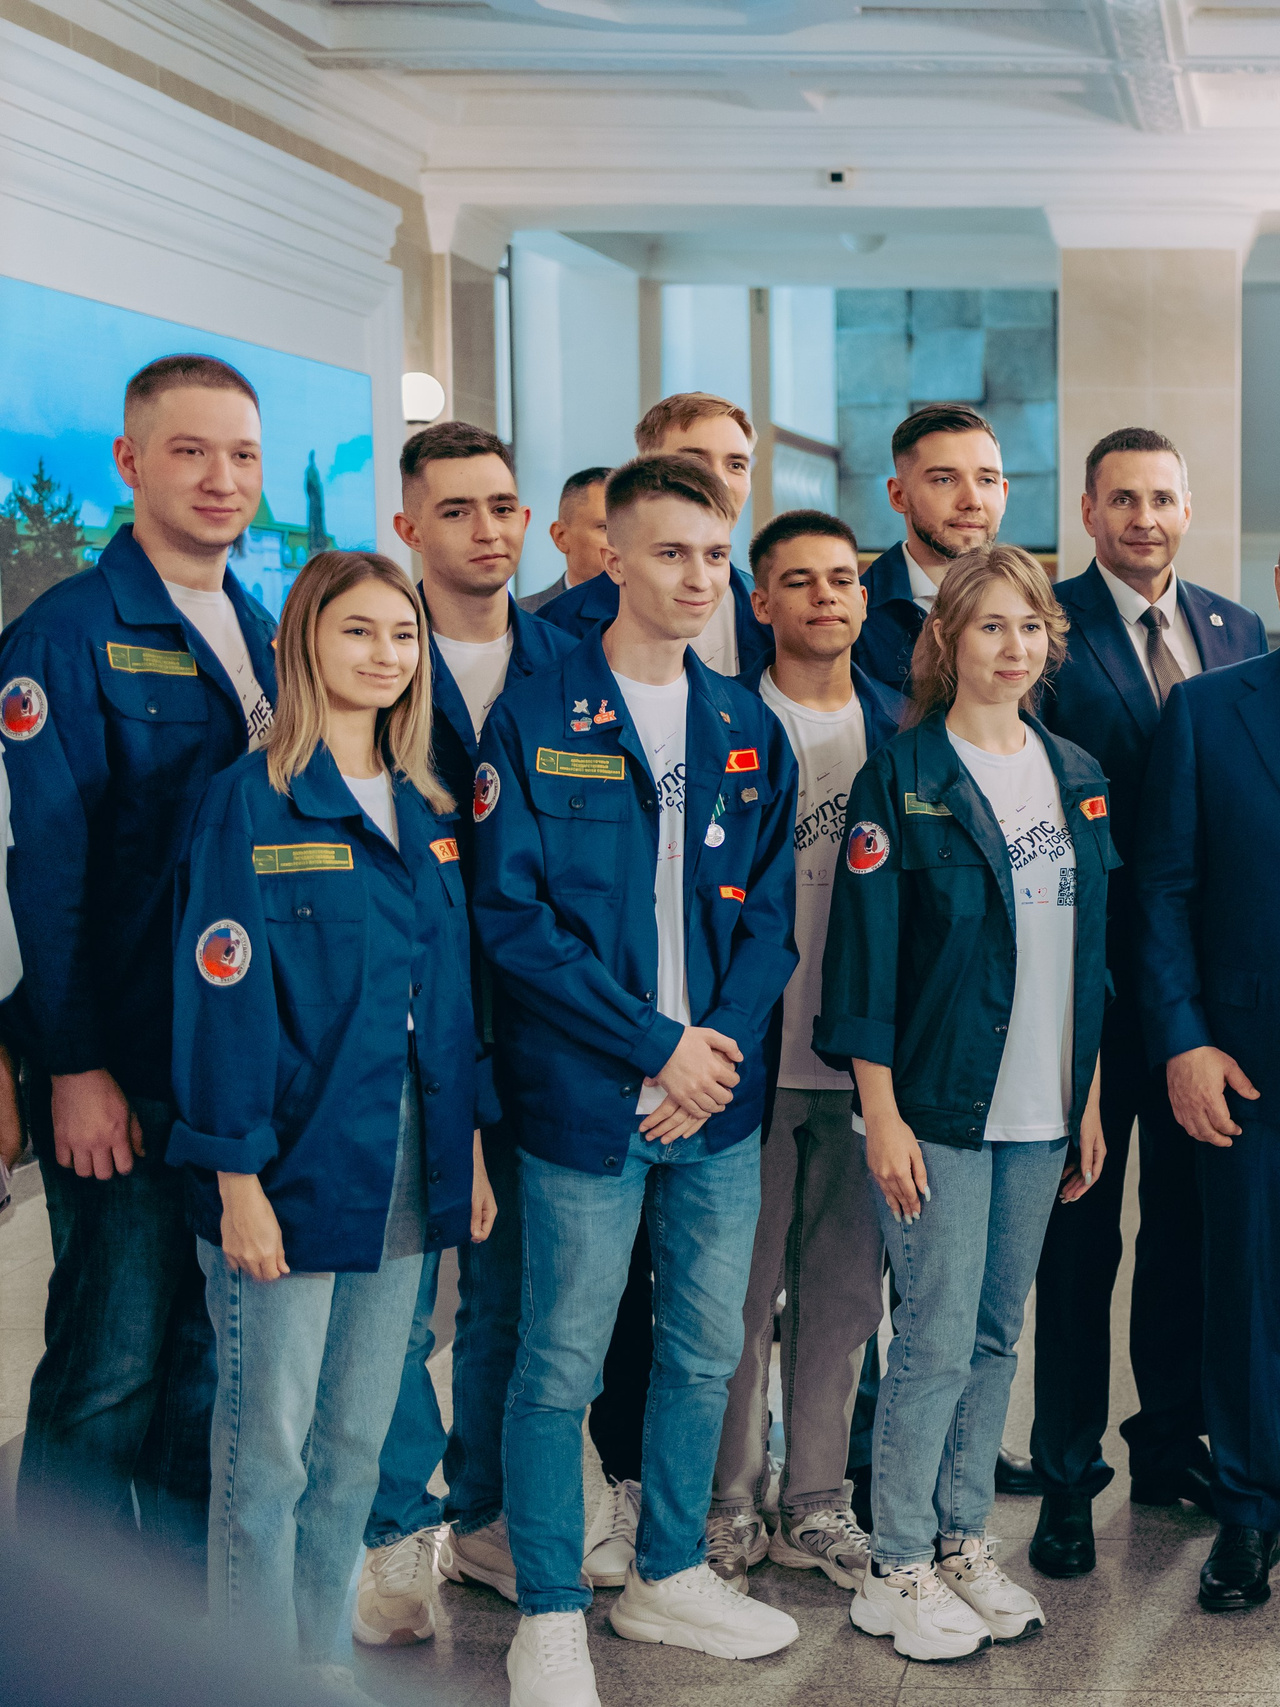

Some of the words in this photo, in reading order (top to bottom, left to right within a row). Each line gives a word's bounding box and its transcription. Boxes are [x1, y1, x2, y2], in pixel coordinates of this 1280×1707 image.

[793, 793, 848, 850] ВГУПС
[1007, 820, 1055, 868] ВГУПС
[1045, 822, 1071, 848] ТОБО
